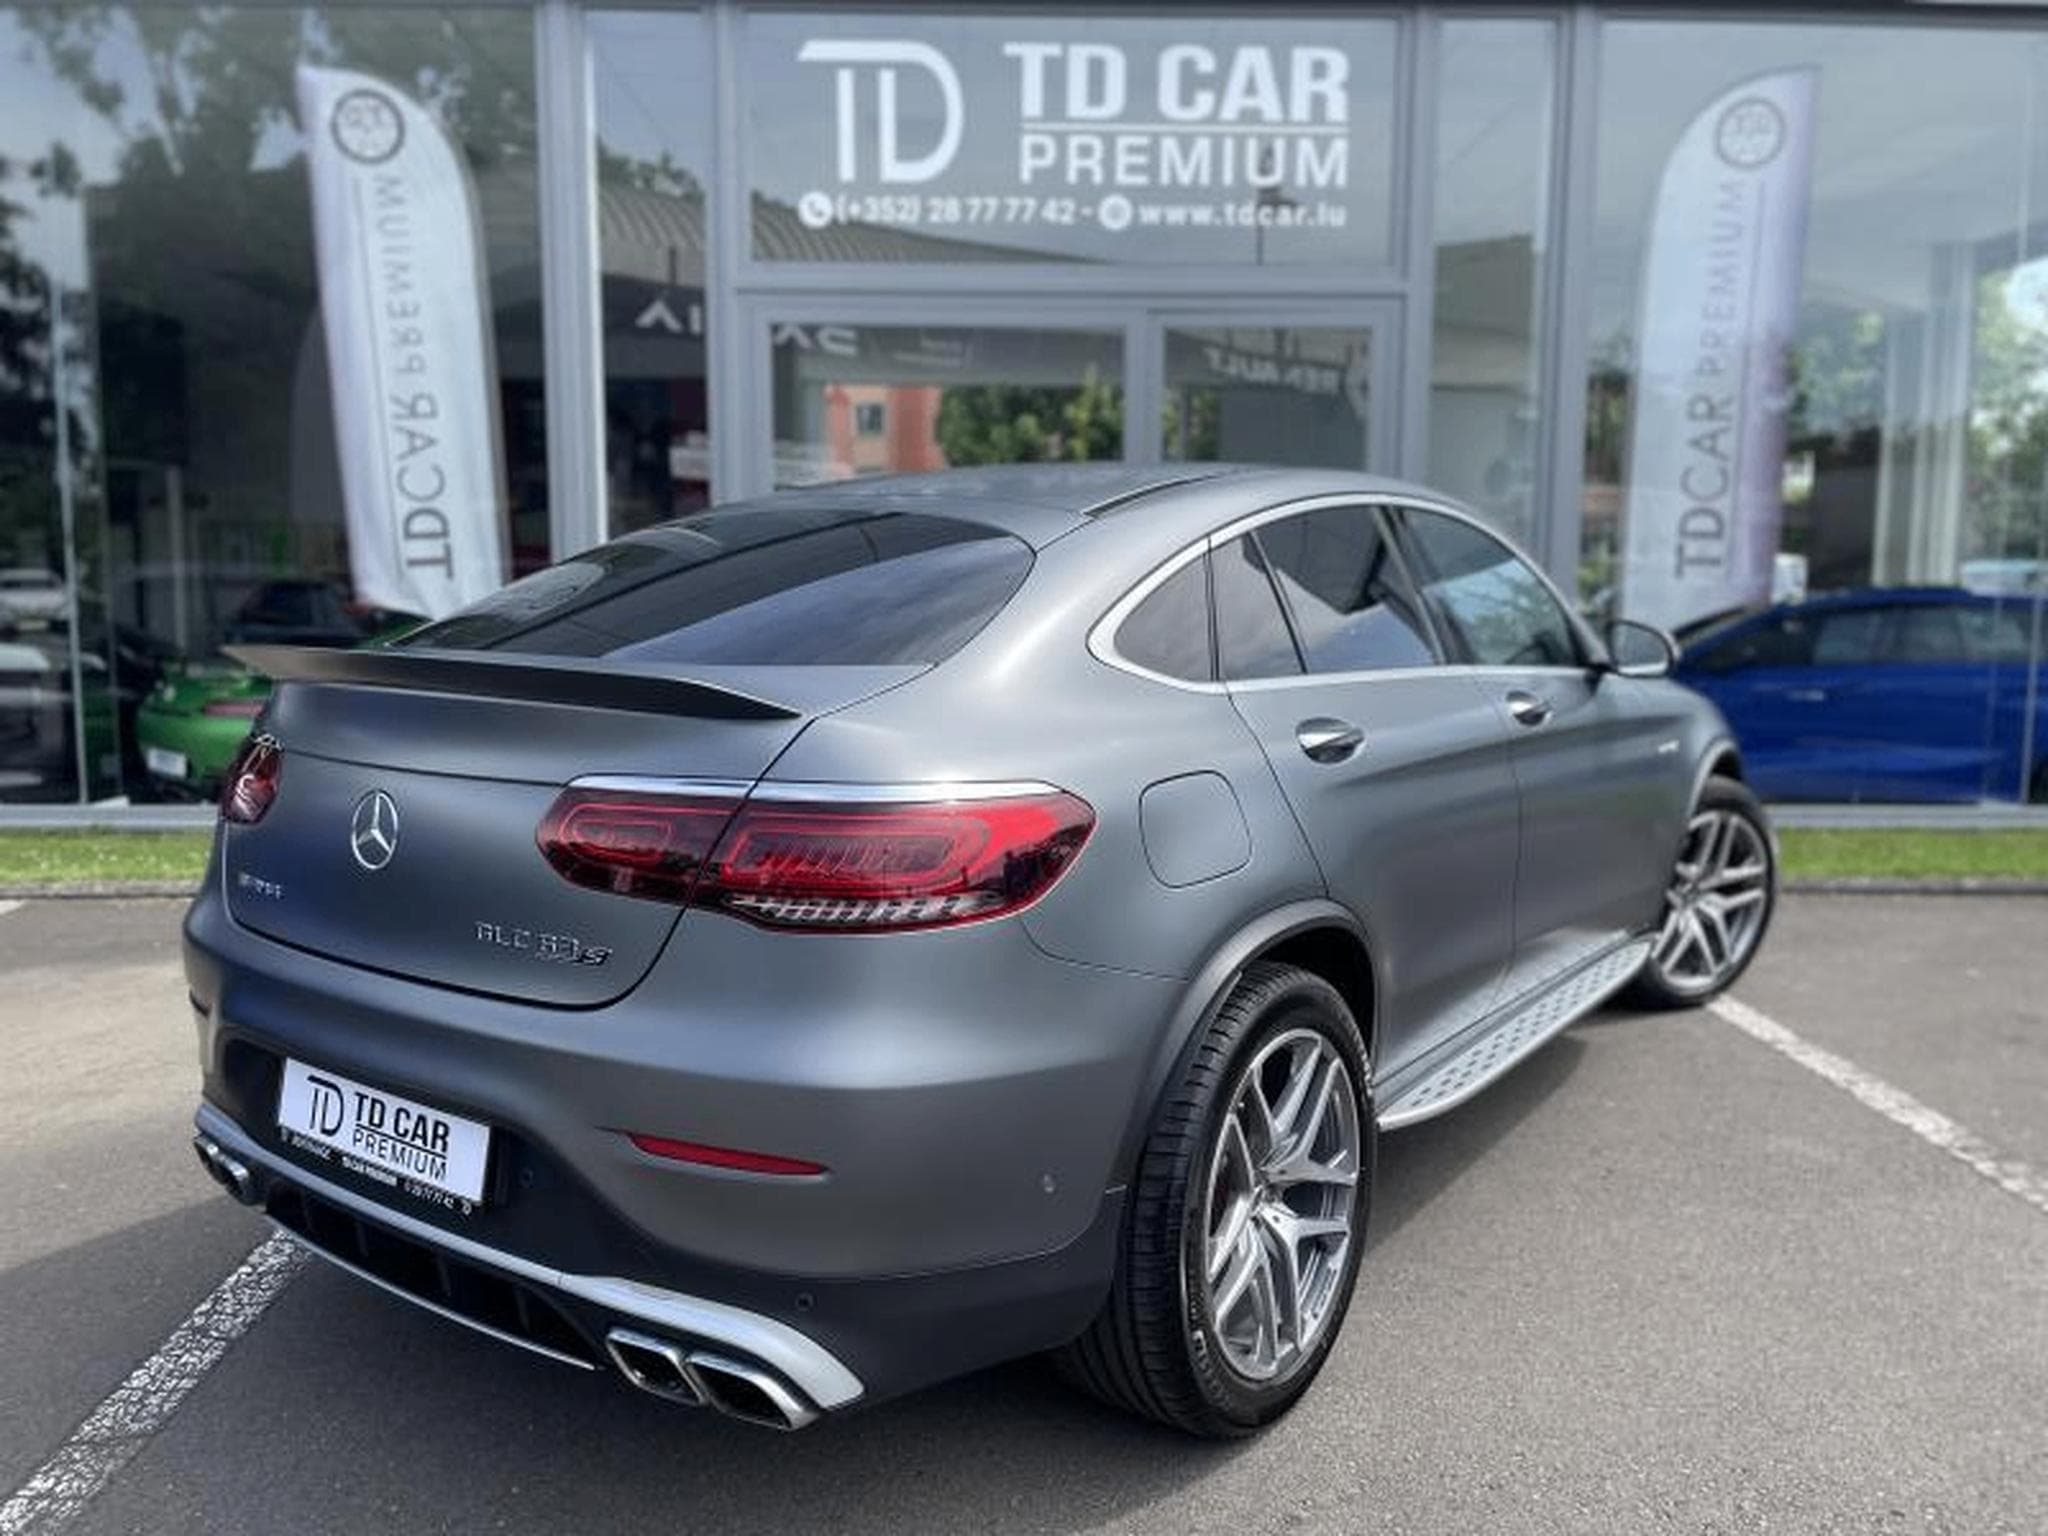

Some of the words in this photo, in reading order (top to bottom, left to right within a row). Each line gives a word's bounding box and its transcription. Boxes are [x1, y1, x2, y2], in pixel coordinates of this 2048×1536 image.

[1004, 43, 1126, 119] TD
[1157, 45, 1349, 122] CAR
[1020, 134, 1348, 187] PREMIUM
[926, 196, 961, 225] 28
[966, 196, 998, 224] 77
[1003, 197, 1037, 225] 77
[1041, 197, 1076, 226] 42
[1138, 200, 1347, 228] www.tdcar.lu
[1694, 177, 1746, 382] PREMIUM
[1674, 396, 1735, 578] TDCAR
[355, 1092, 385, 1129] TD
[394, 1107, 450, 1153] CAR
[353, 1128, 447, 1182] PREMIUM
